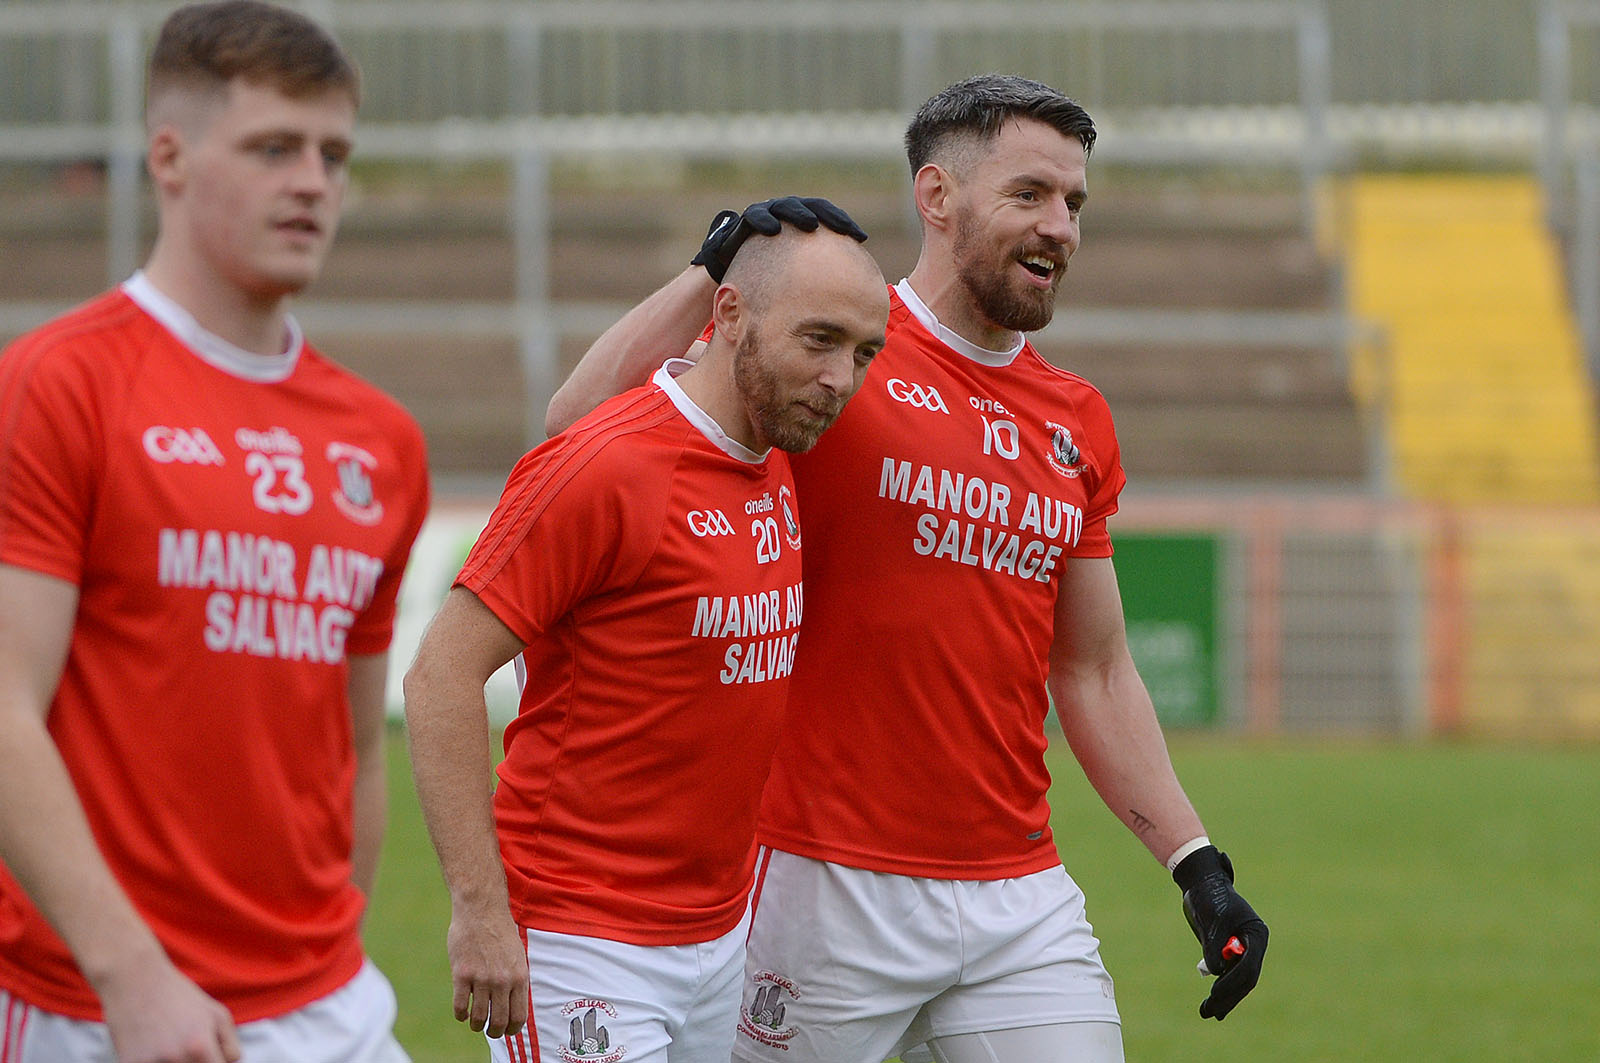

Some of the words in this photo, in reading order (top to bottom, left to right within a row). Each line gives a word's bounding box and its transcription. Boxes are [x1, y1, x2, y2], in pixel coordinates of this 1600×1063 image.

[980, 414, 1020, 461] 10
[244, 451, 314, 516] 23
[878, 457, 1012, 527] MANOR
[1018, 491, 1083, 548] AUTO
[158, 528, 297, 600] MANOR
[751, 516, 781, 564] 20
[913, 513, 1063, 583] SALVAGE
[204, 591, 354, 665] SALVAG
[691, 590, 781, 638] MANOR
[784, 581, 804, 630] AU
[719, 631, 800, 685] SALVAG
